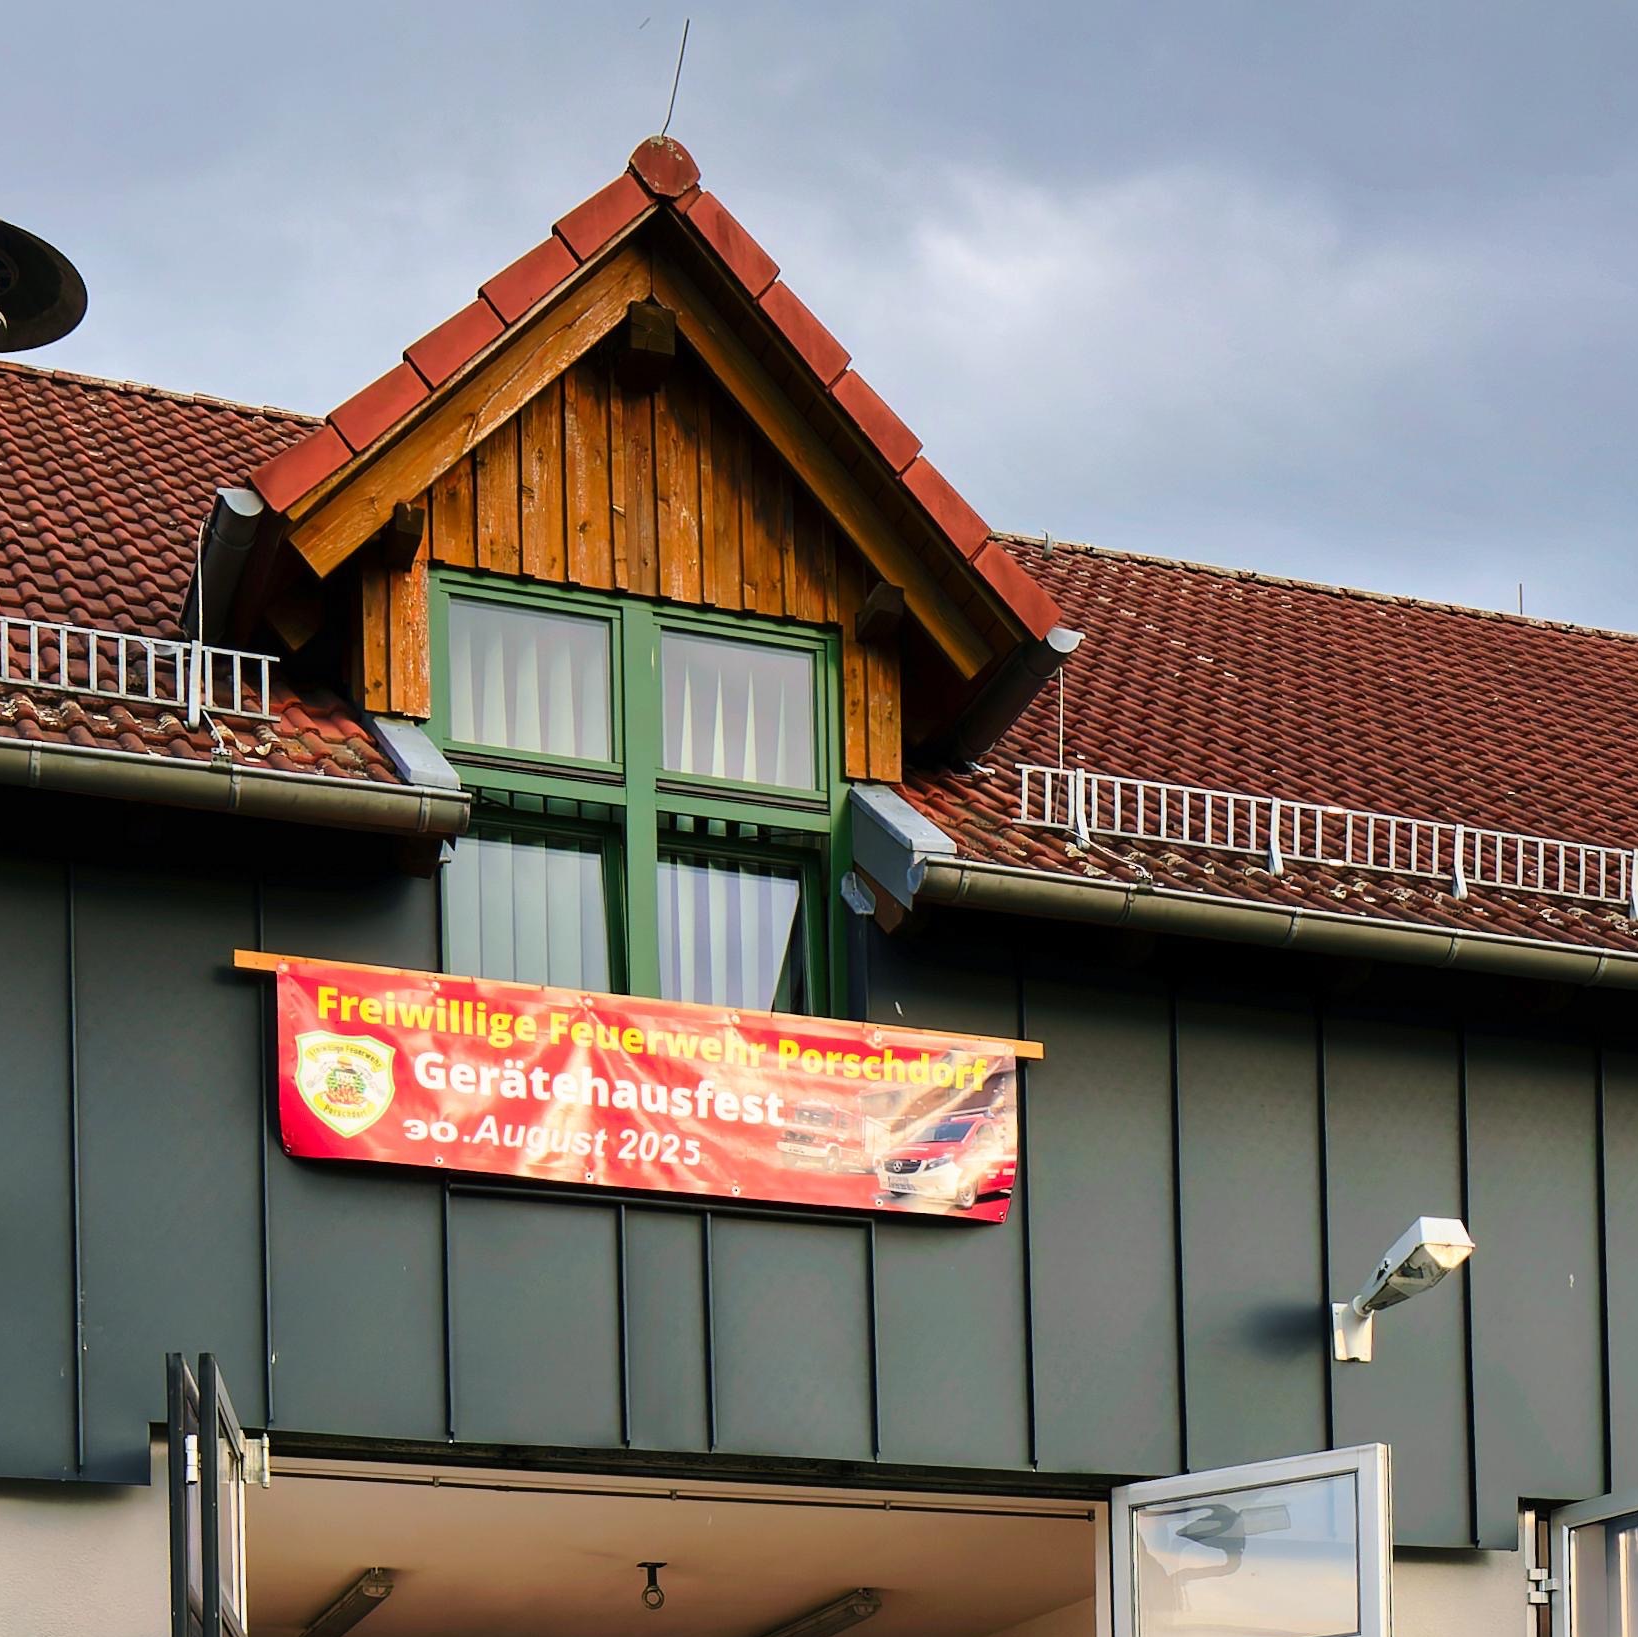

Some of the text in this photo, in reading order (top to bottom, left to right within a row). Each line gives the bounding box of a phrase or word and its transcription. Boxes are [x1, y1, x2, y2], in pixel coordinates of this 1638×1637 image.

[317, 985, 989, 1091] Freiwillige Feuerwehr Porschdorf
[413, 1051, 785, 1127] Gerätehausfest
[617, 1127, 702, 1167] 2025
